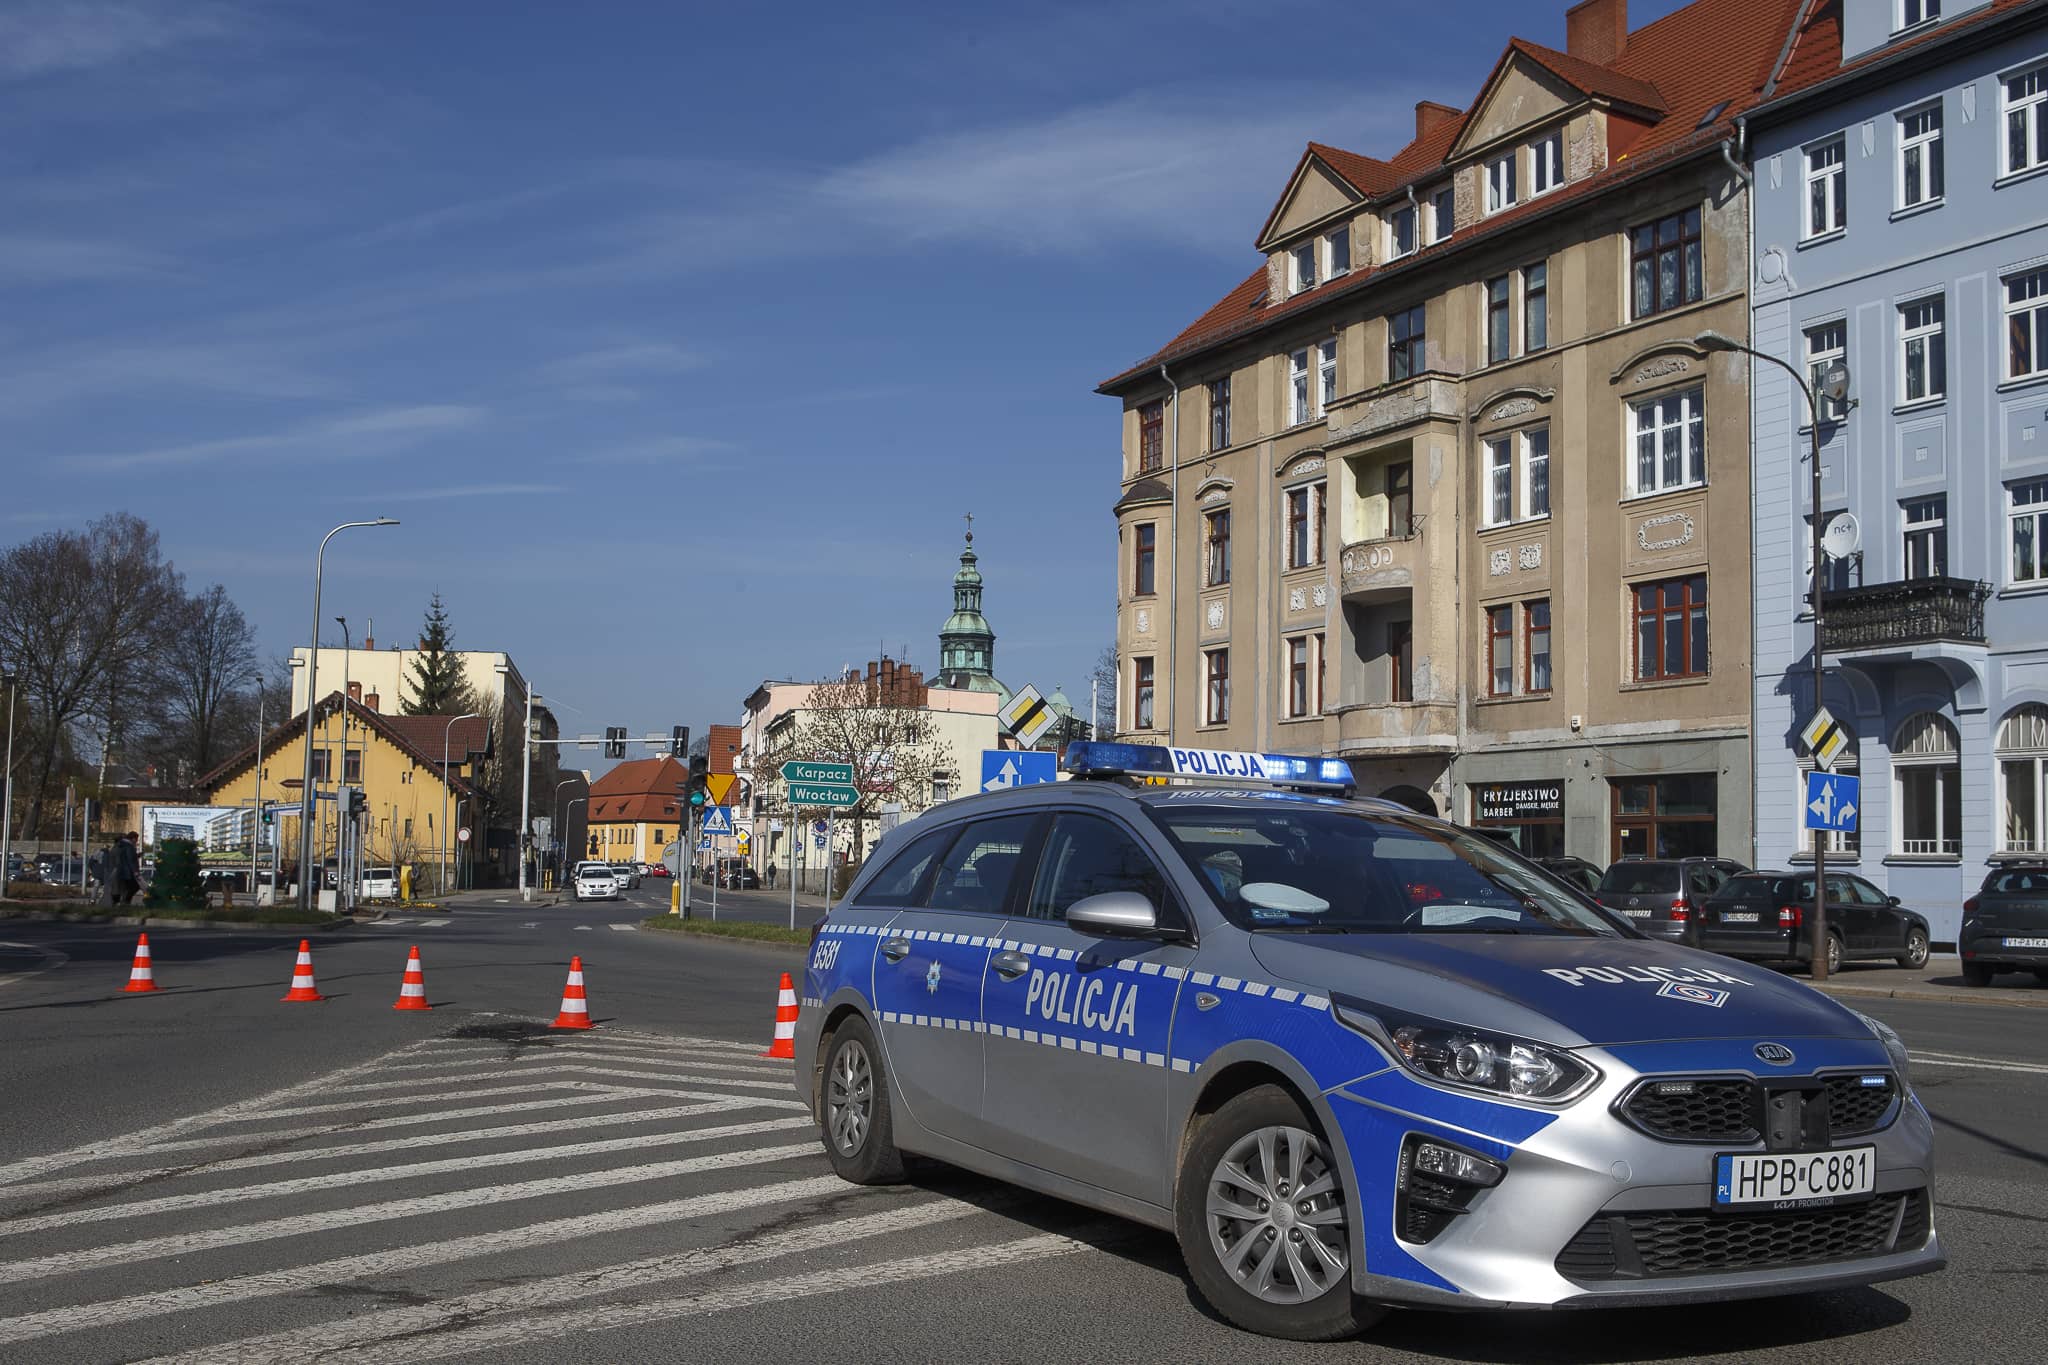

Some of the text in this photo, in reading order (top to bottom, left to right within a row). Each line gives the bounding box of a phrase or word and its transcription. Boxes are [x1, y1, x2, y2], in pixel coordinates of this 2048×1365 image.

[1834, 523, 1852, 535] nc+
[1173, 749, 1265, 777] POLICJA
[796, 766, 847, 782] Karpacz
[795, 788, 850, 802] Wrocław
[1483, 788, 1559, 802] FRYZJERSTWO
[1483, 807, 1513, 817] BARBER
[813, 940, 842, 970] B581
[1541, 966, 1754, 986] POLICJA
[1025, 968, 1138, 1037] POLICJA
[1739, 1152, 1866, 1198] HPB C881
[1718, 1186, 1729, 1196] PL
[1798, 1197, 1834, 1208] PROMOTOR
